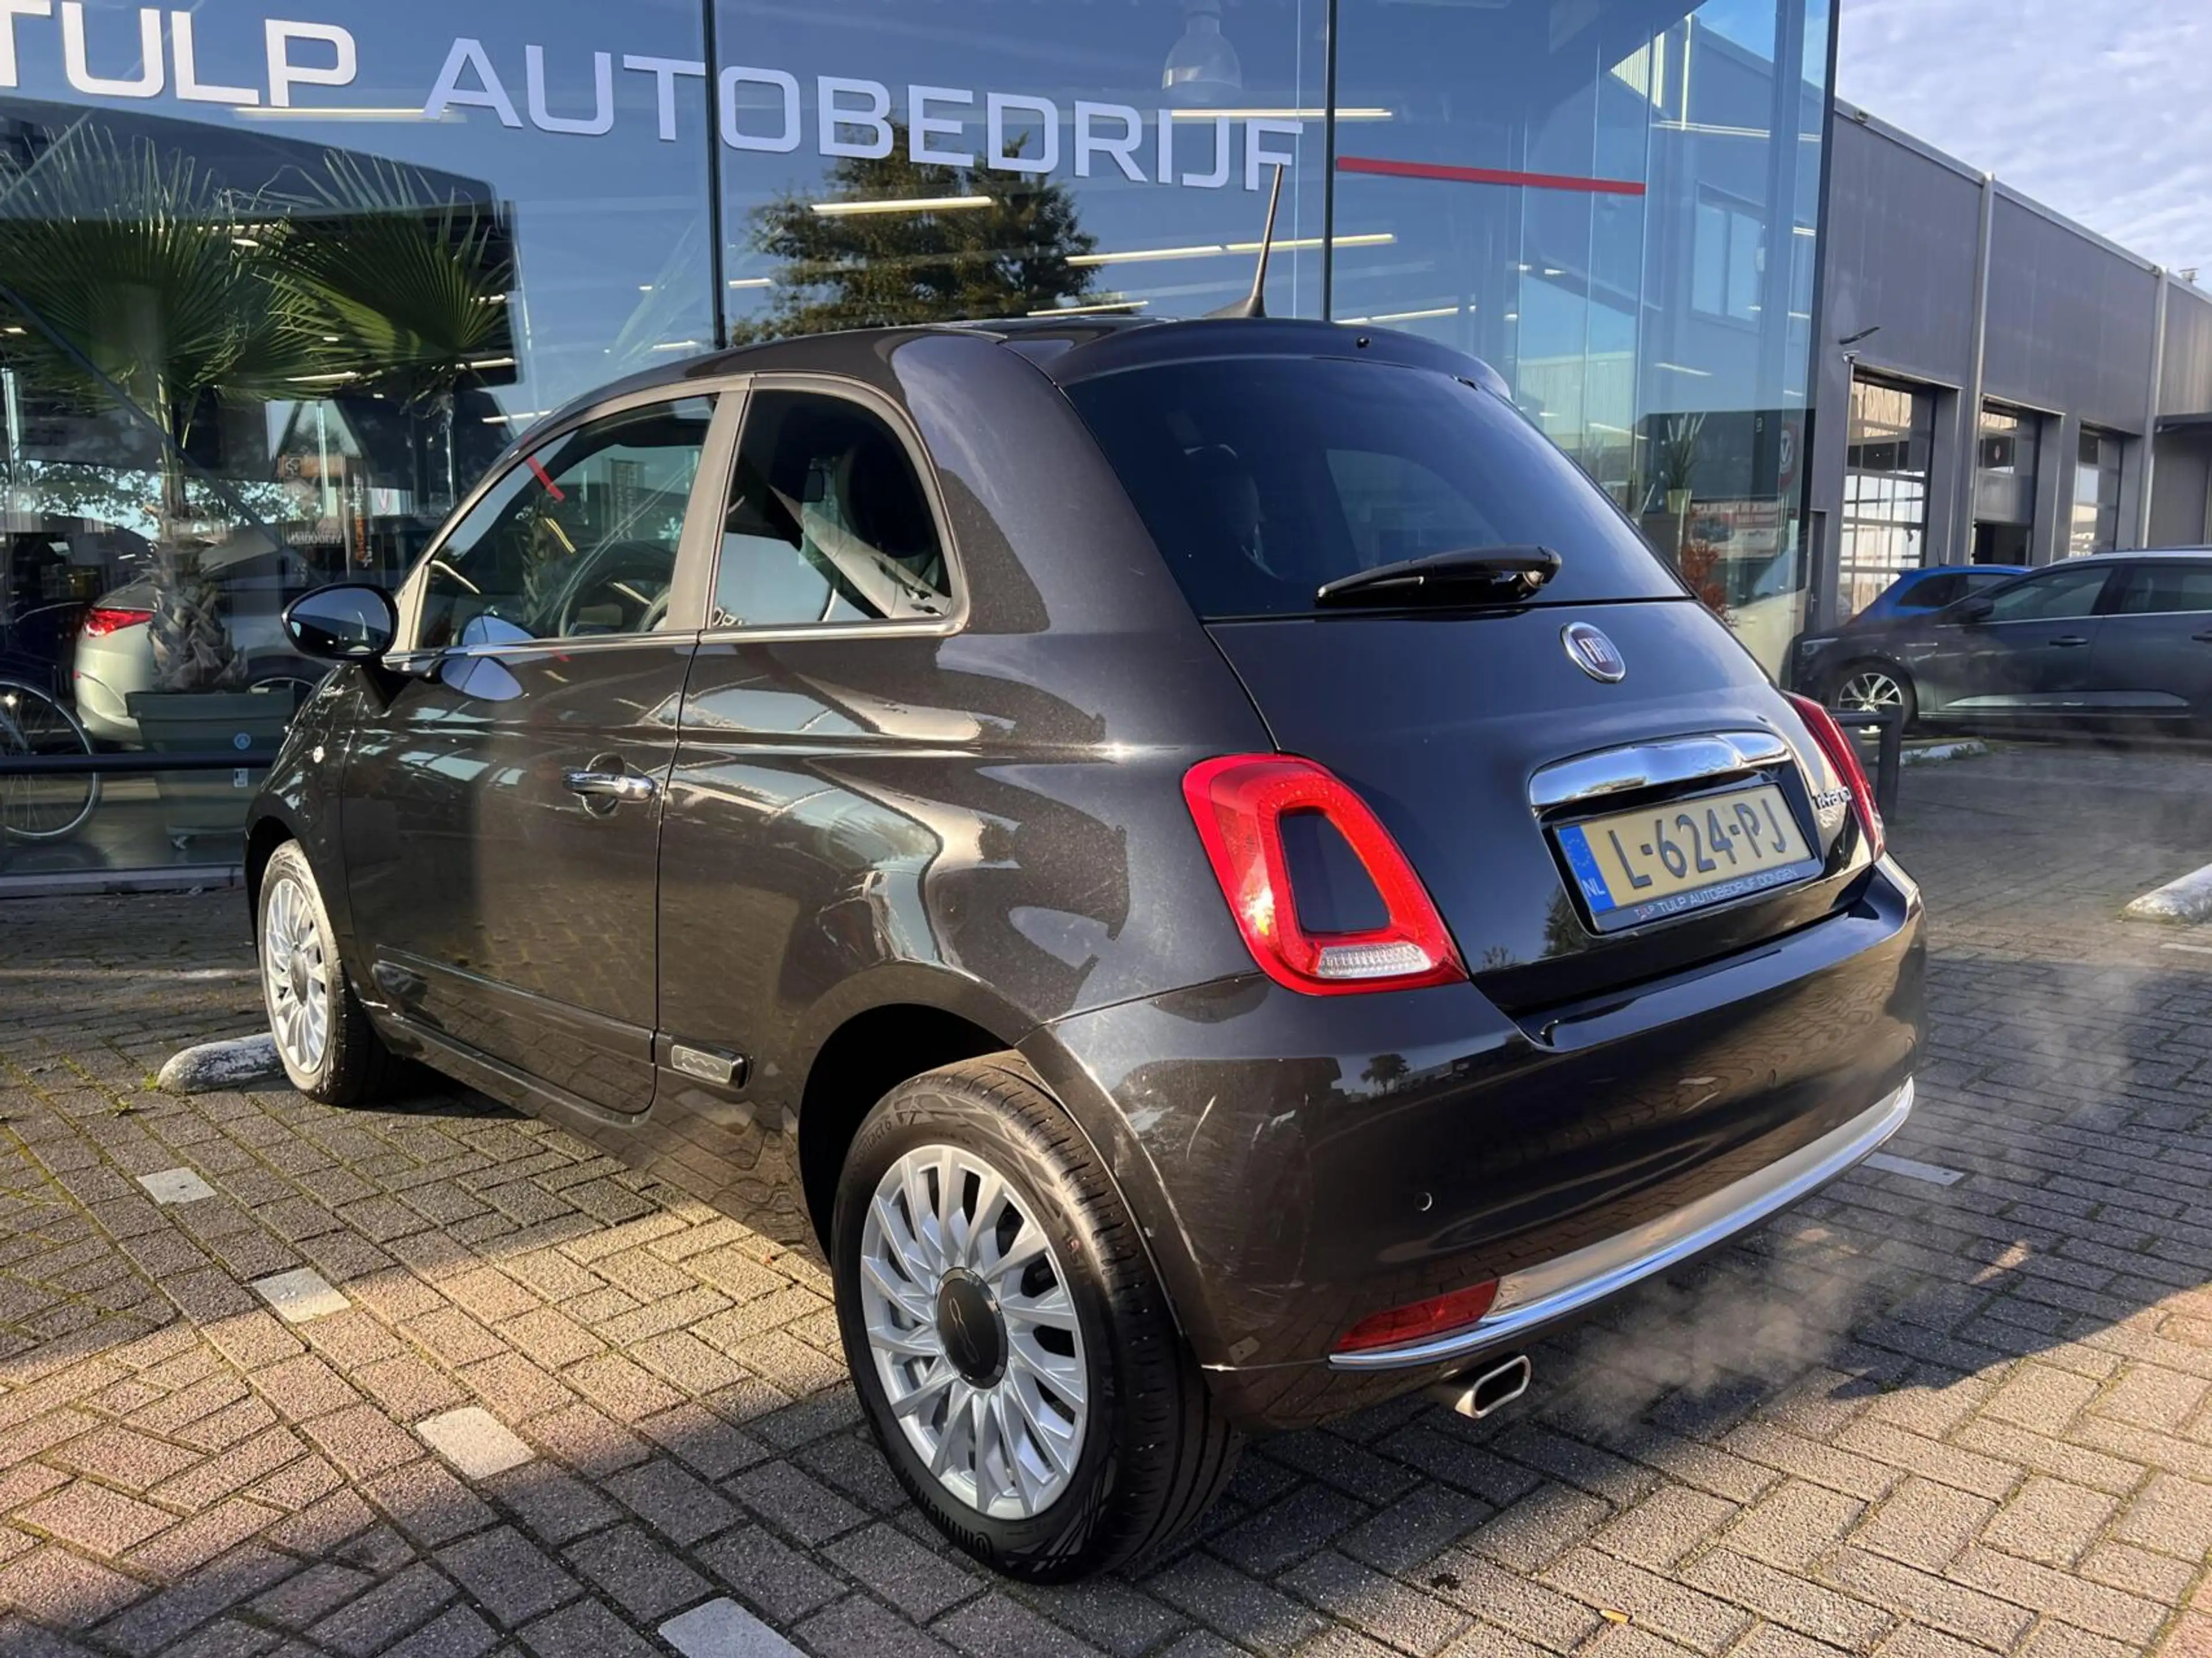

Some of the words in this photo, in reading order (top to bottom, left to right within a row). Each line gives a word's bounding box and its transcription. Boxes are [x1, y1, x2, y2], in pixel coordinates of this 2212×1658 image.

[0, 0, 357, 107] TULP
[422, 37, 1303, 191] AUTOBEDRIJF
[1578, 636, 1614, 664] FIAT
[1608, 797, 1787, 890] L-624-PJ
[1582, 878, 1606, 897] NL
[1659, 897, 1687, 915] TULP
